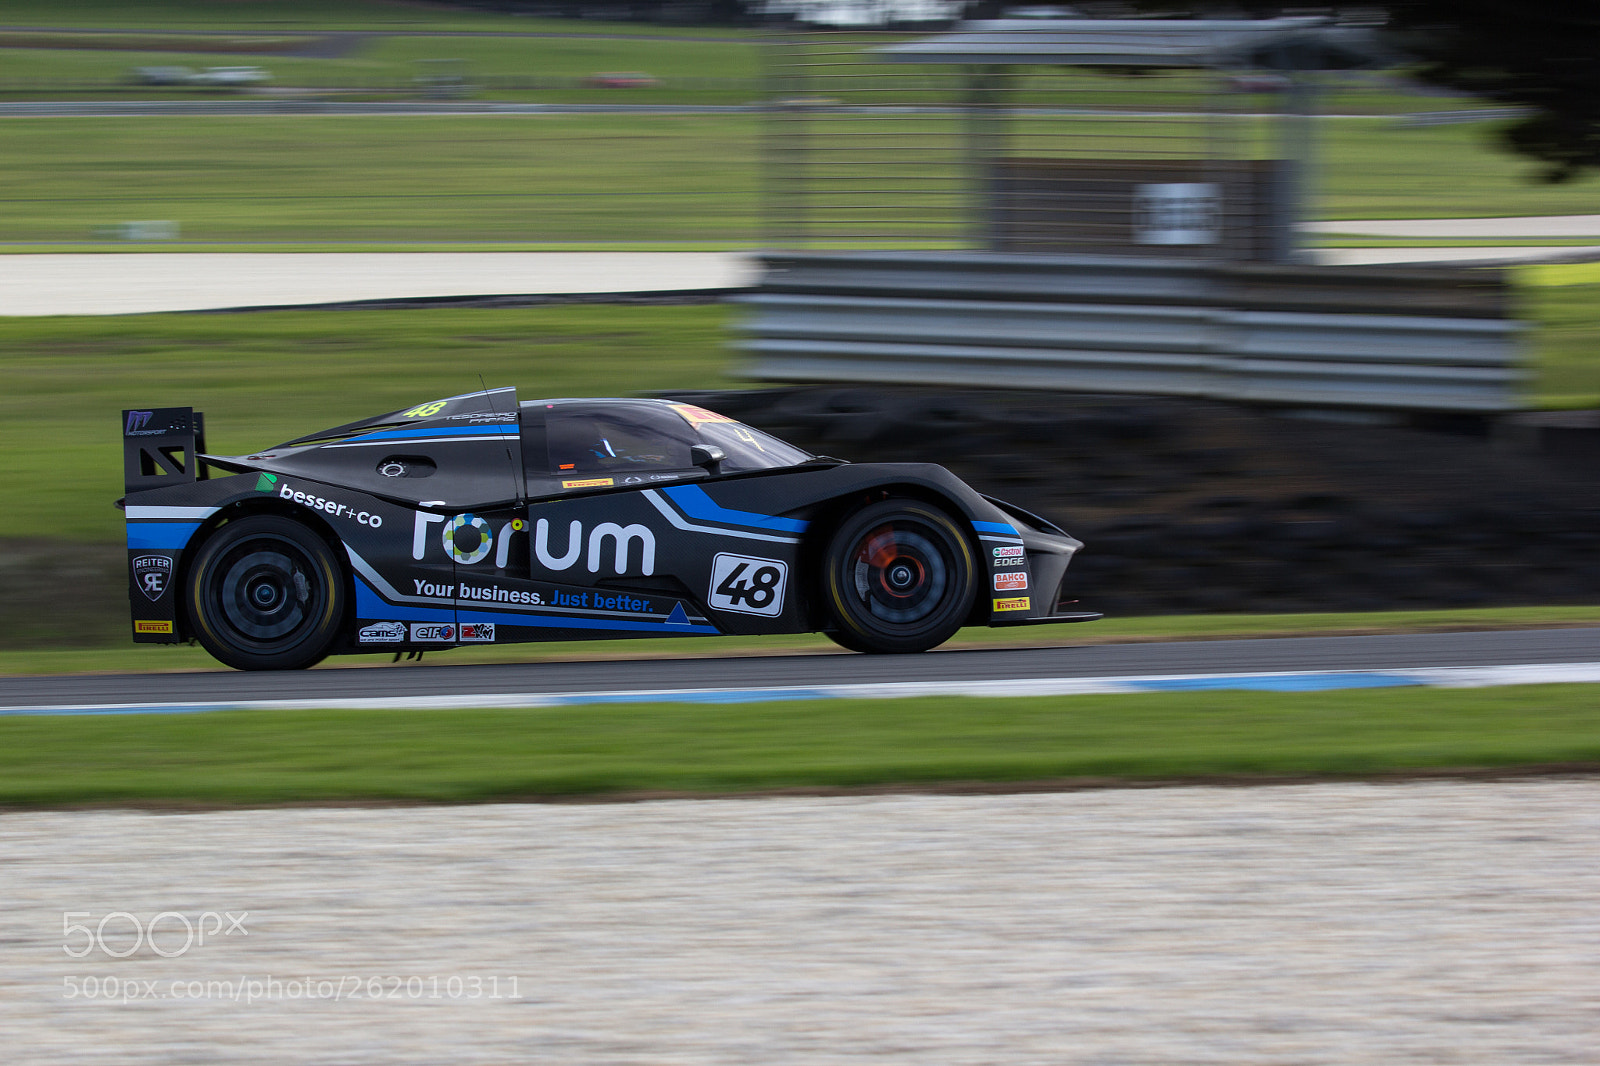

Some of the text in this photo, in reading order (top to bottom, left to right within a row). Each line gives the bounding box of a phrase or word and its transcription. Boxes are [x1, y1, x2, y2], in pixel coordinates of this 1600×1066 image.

[402, 402, 448, 418] 48
[1000, 548, 1022, 556] Castrol
[136, 558, 170, 569] REITER
[993, 557, 1025, 567] EDGE
[996, 573, 1025, 582] BAHCO
[716, 562, 781, 609] 48
[413, 578, 653, 613] Your business. Just better.
[997, 599, 1027, 610] PIRELLI
[138, 623, 169, 631] PIRELLI
[360, 630, 398, 638] cams
[416, 627, 442, 639] elf
